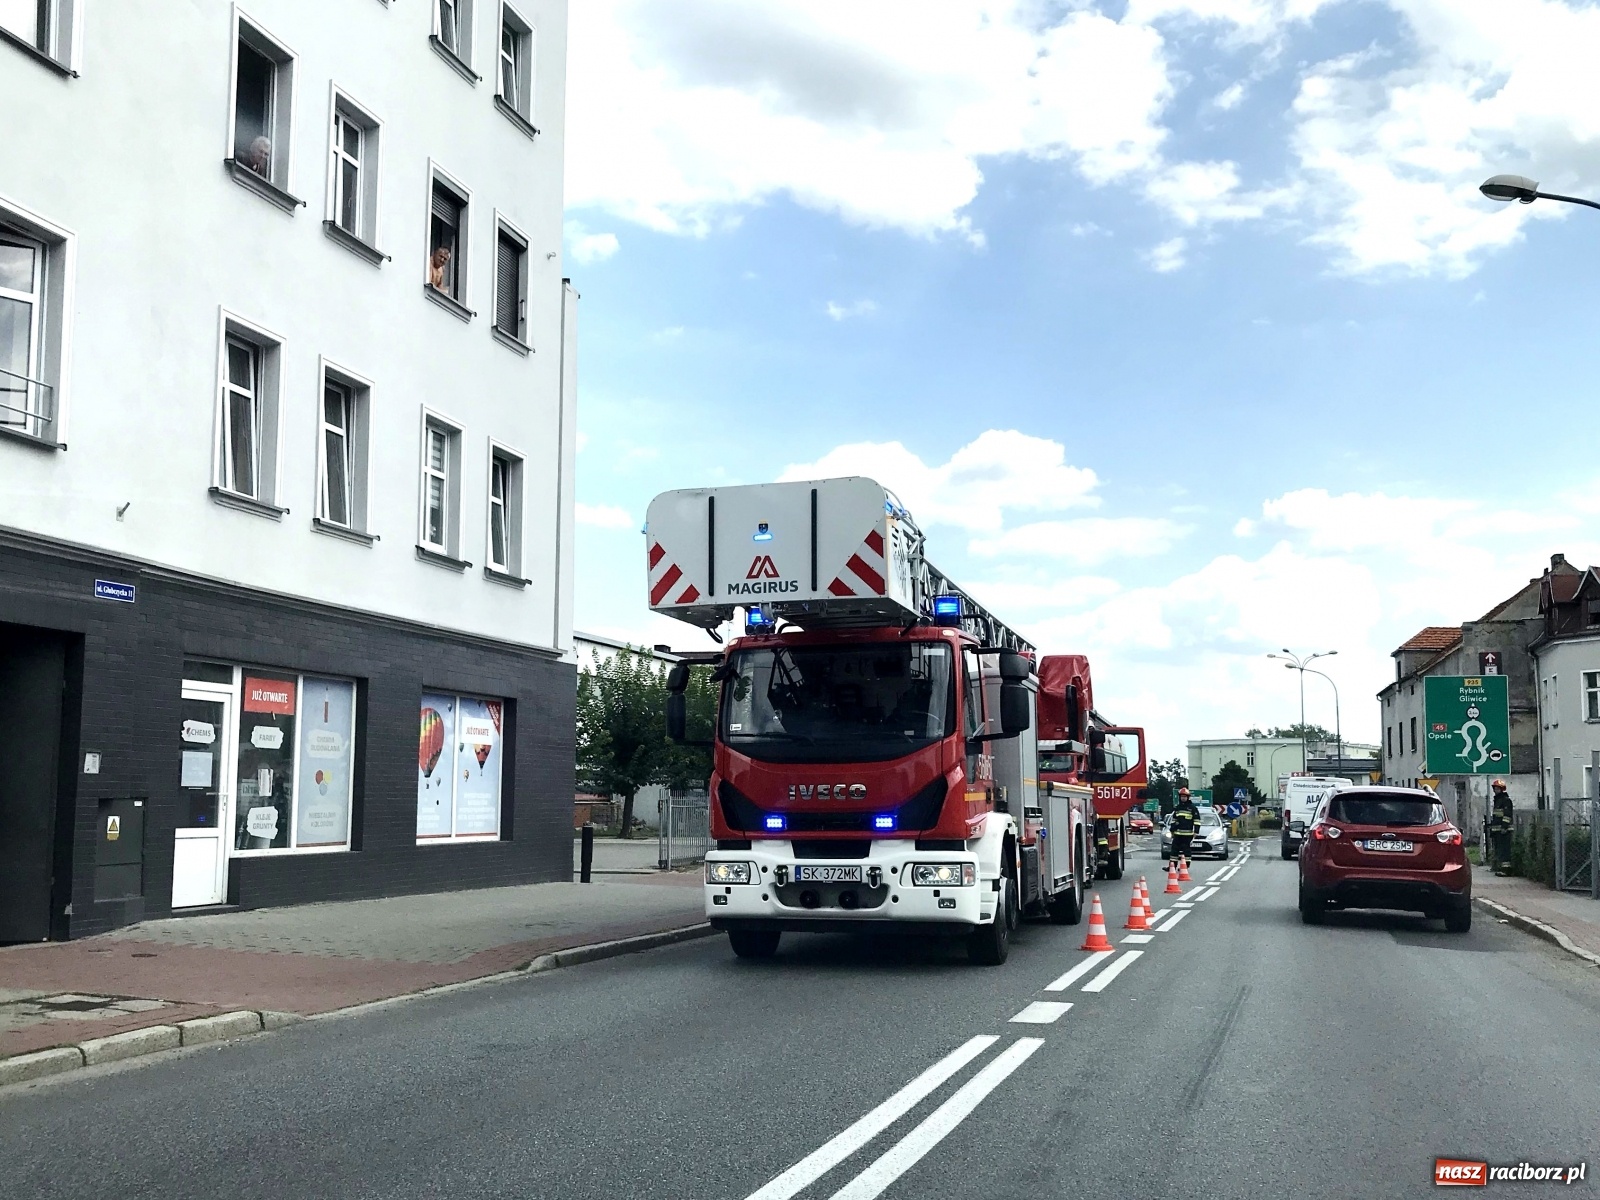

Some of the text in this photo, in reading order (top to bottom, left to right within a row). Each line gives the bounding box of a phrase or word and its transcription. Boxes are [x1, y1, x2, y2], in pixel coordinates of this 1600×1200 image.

[728, 580, 799, 595] MAGIRUS
[1459, 687, 1485, 696] Rybnik
[251, 689, 288, 704] JUŻ OTWARTE
[259, 734, 277, 742] FARBY
[1428, 732, 1452, 740] Opole
[788, 783, 867, 801] IVECO
[252, 822, 274, 830] GRUNTY
[1369, 840, 1388, 849] SRC
[802, 867, 858, 880] SK 372MK
